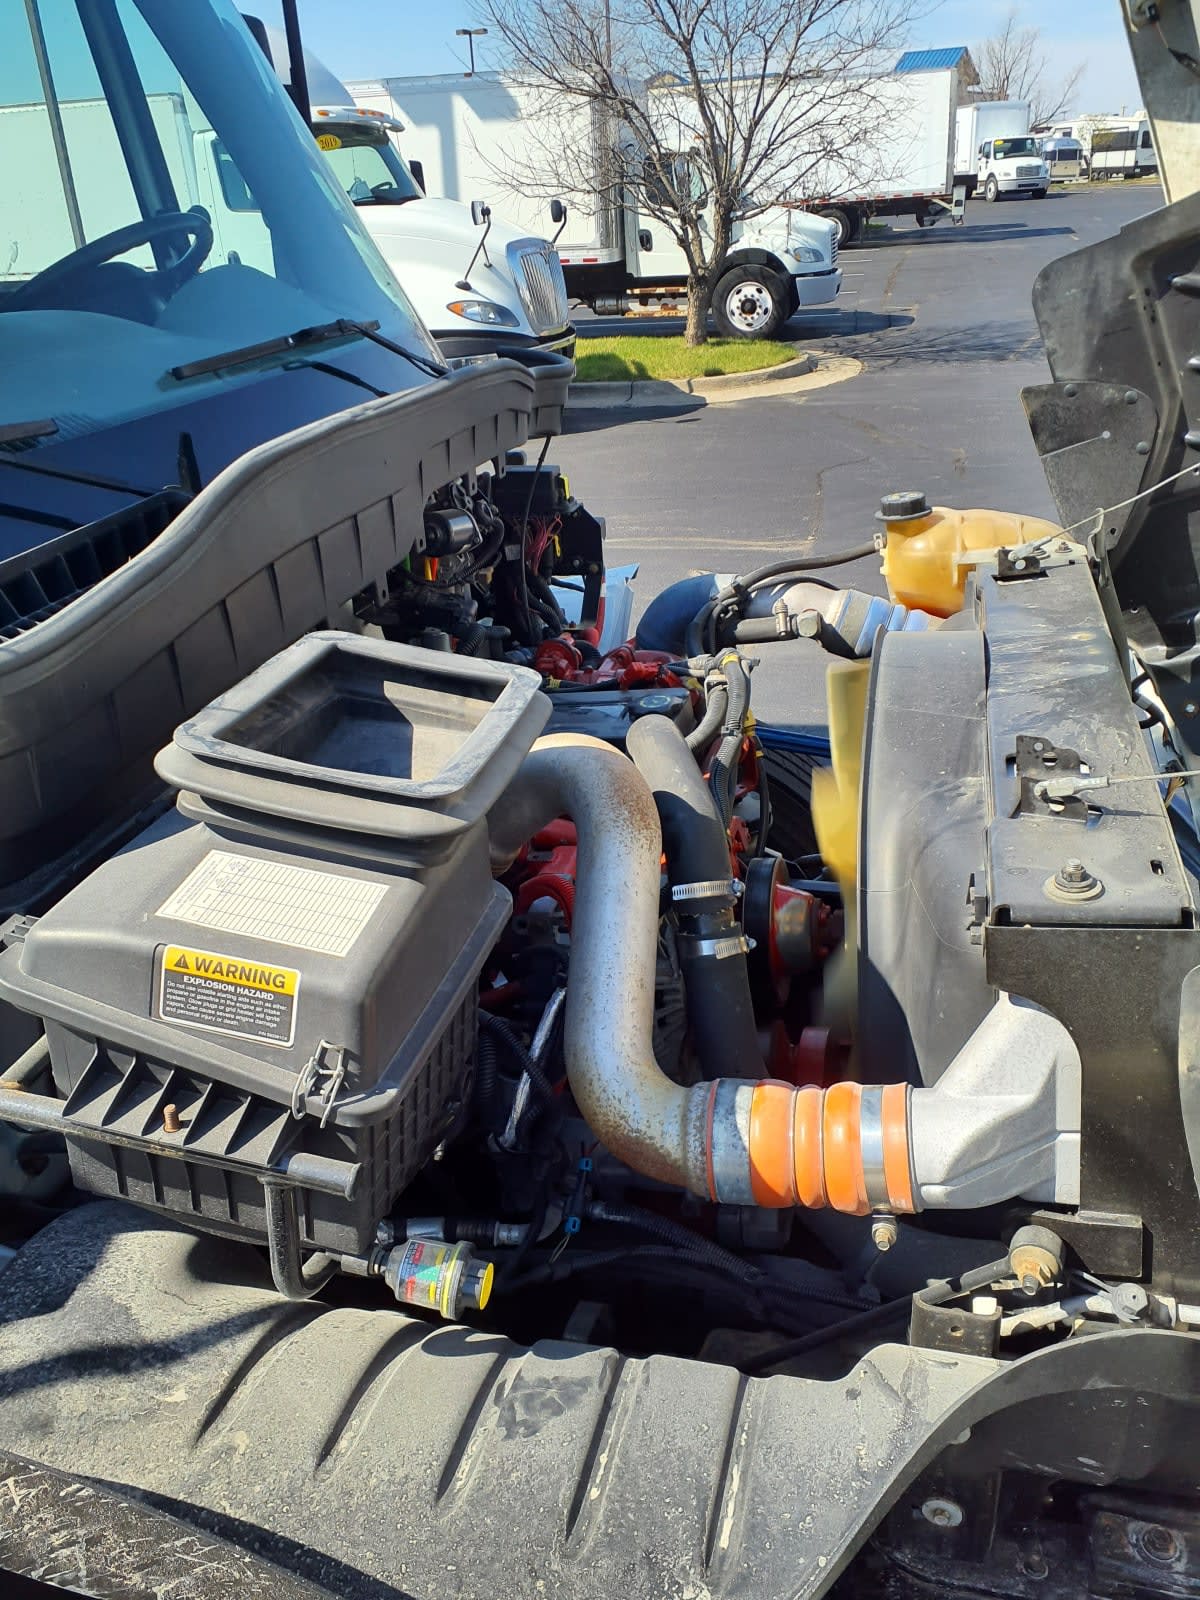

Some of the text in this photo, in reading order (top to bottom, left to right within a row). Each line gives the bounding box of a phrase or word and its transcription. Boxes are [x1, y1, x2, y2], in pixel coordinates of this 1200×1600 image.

[194, 956, 286, 989] WARNING
[183, 975, 274, 1000] EXPLOSION HAZARD
[166, 987, 189, 996] propane
[196, 993, 219, 1003] gasoline
[236, 1002, 254, 1011] engine
[263, 1007, 280, 1015] intake
[188, 997, 202, 1005] Glow
[202, 1000, 217, 1009] plugs
[265, 1013, 280, 1023] ignite
[176, 1008, 200, 1018] personal
[200, 1013, 215, 1021] injury
[216, 1010, 234, 1018] severe
[235, 1014, 254, 1023] engine
[254, 1018, 276, 1028] damage
